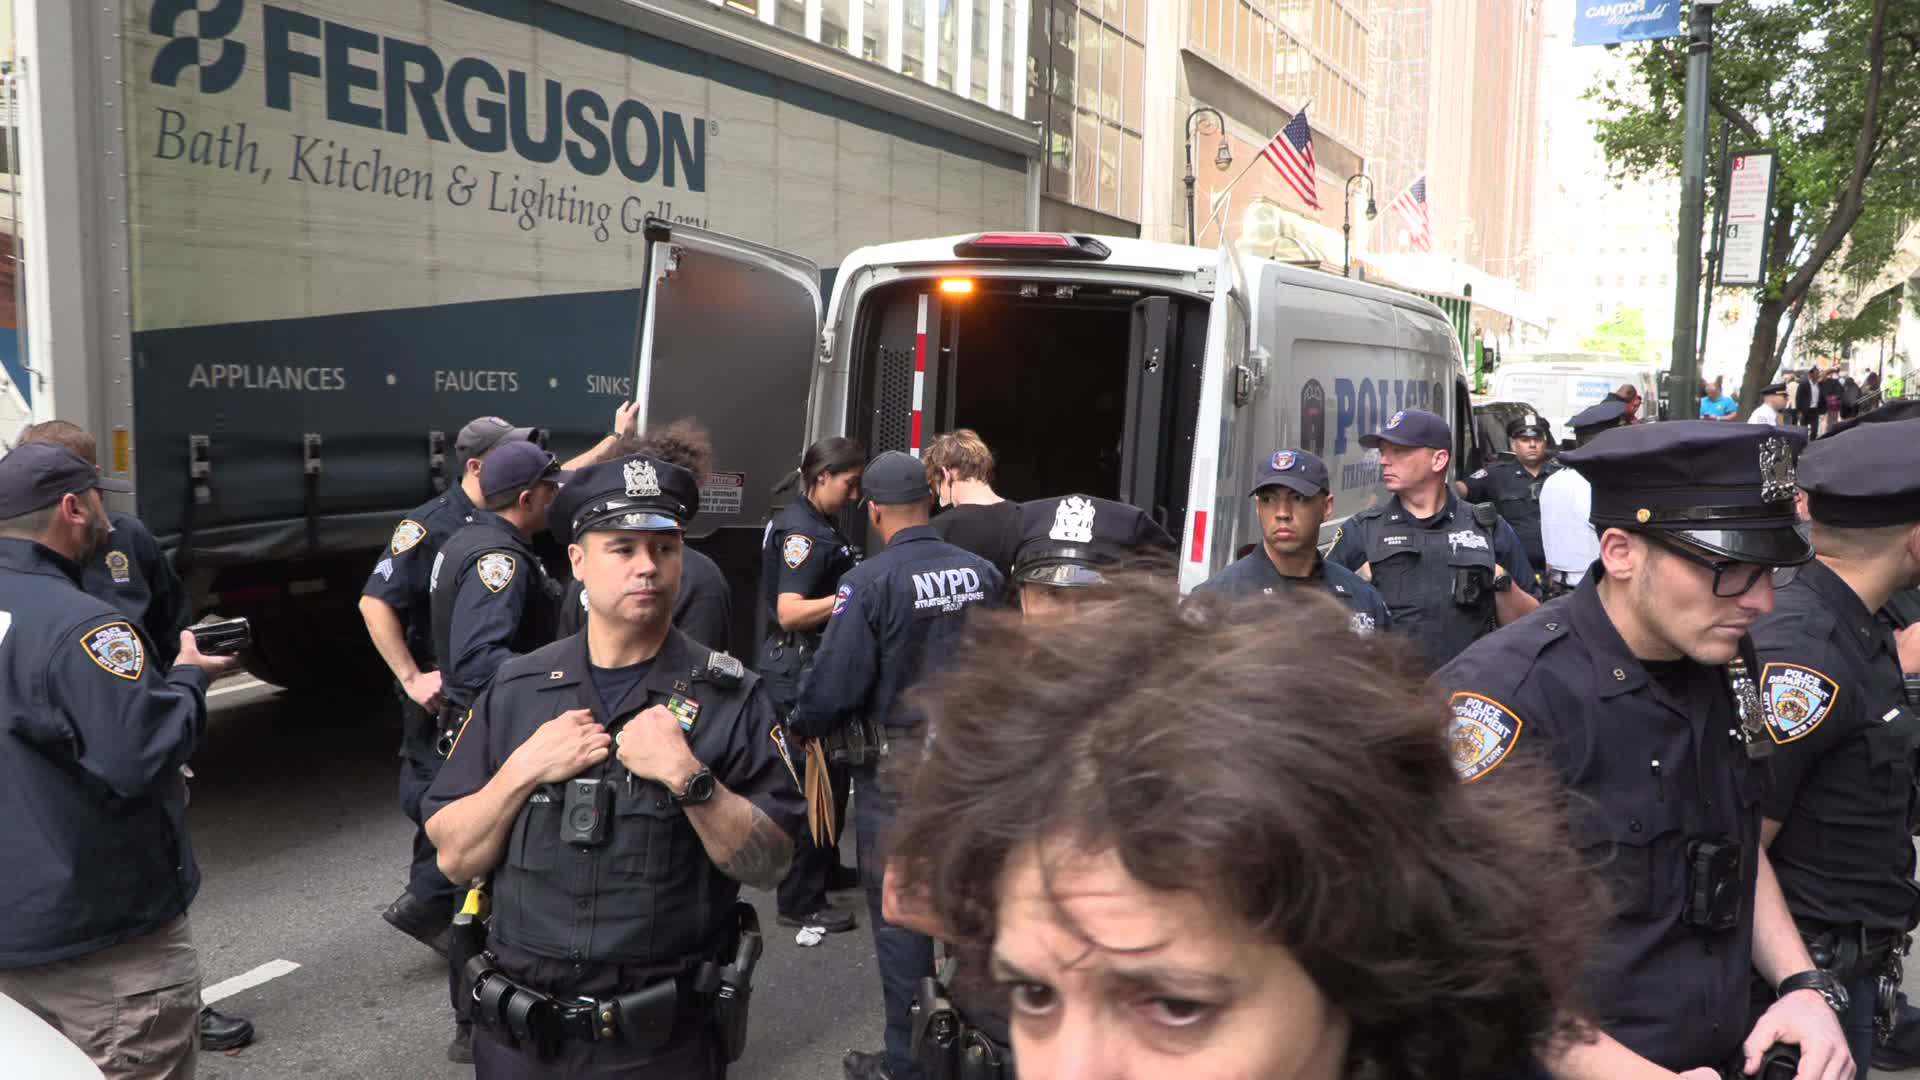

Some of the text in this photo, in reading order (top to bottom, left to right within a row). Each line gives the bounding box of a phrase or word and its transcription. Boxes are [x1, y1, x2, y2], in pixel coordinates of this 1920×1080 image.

[263, 4, 706, 193] FERGUSON
[153, 106, 272, 185] Bath,
[287, 133, 434, 202] Kitchen
[446, 164, 478, 207] &
[487, 169, 613, 243] Lighting
[1734, 156, 1744, 170] 3
[187, 363, 632, 396] APPLIANCES FAUCETS SINKS
[912, 568, 979, 600] NYPD
[915, 596, 951, 609] STRATEGIC
[1613, 668, 1626, 681] 9
[1784, 668, 1821, 687] POLICE
[1768, 675, 1829, 700] DEPARTMENT
[1464, 697, 1503, 721] POLICE
[1763, 692, 1772, 712] CITY
[1479, 744, 1505, 768] YORK
